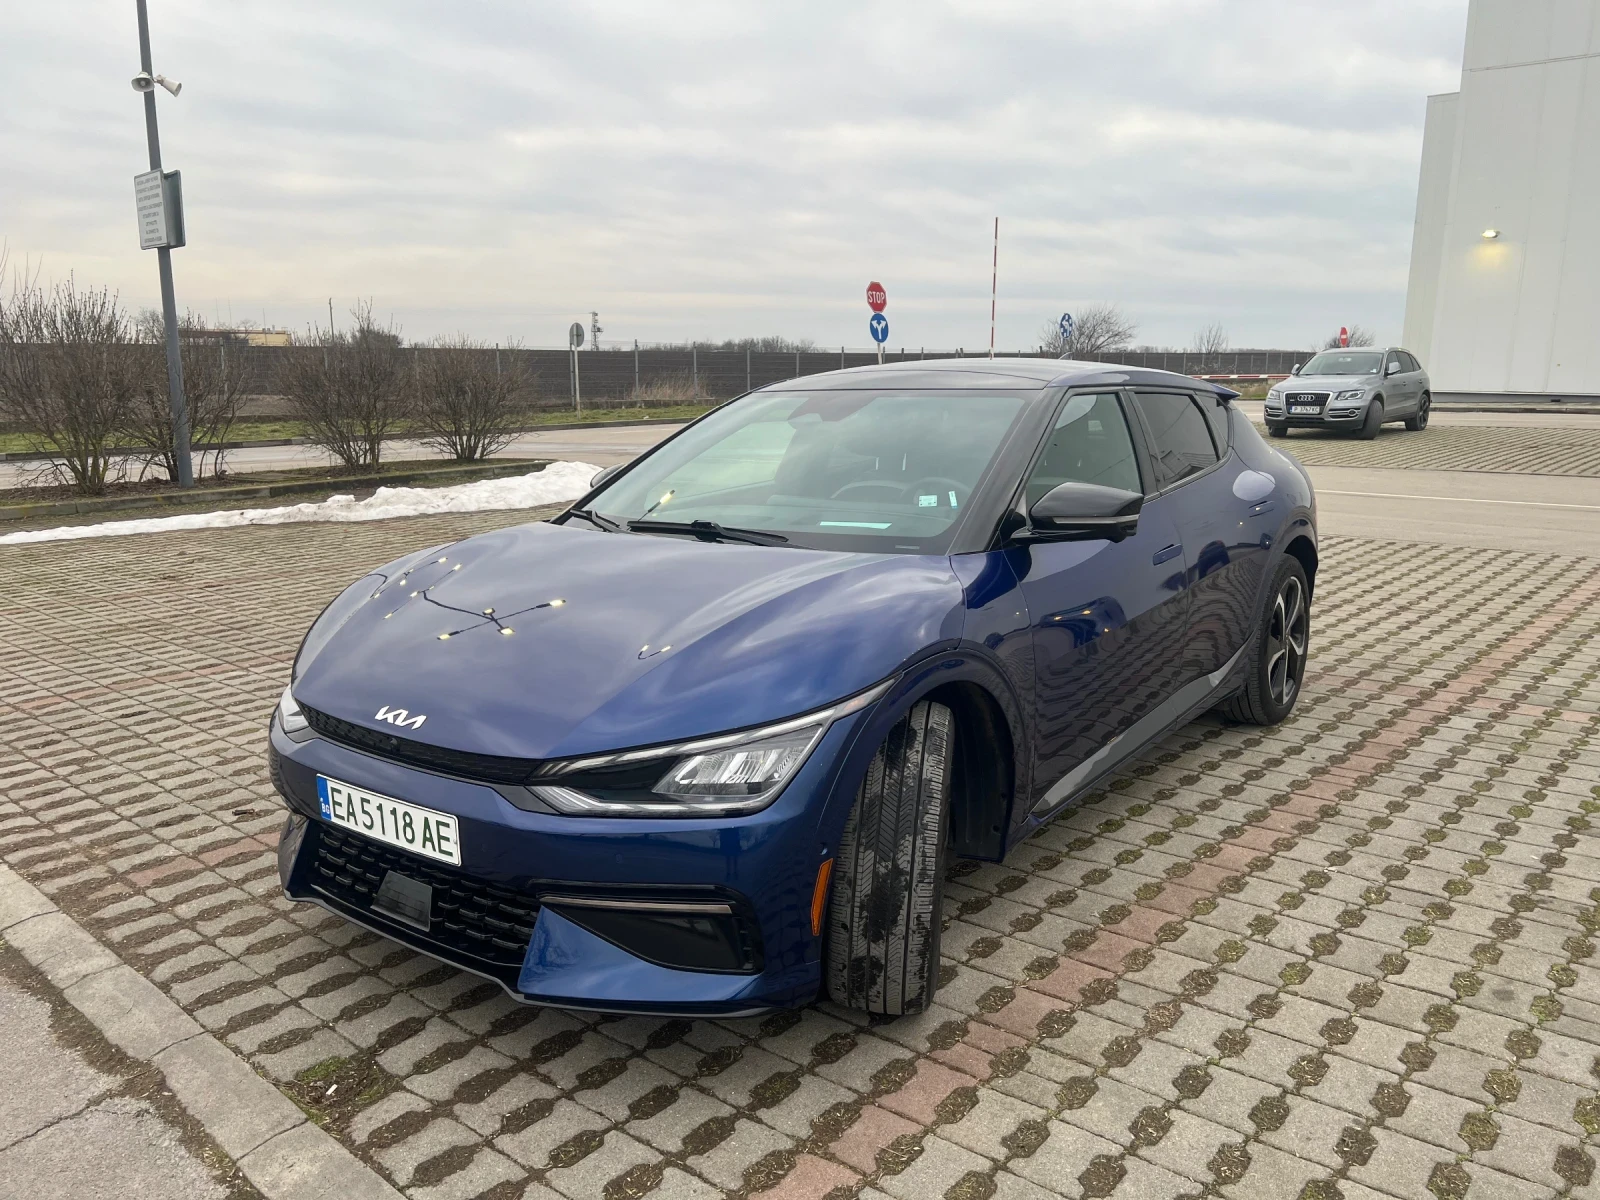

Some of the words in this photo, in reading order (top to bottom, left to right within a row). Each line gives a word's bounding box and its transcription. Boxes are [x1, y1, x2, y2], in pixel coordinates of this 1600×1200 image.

[868, 290, 885, 304] STOP
[374, 705, 427, 730] KIA
[321, 802, 330, 815] BG
